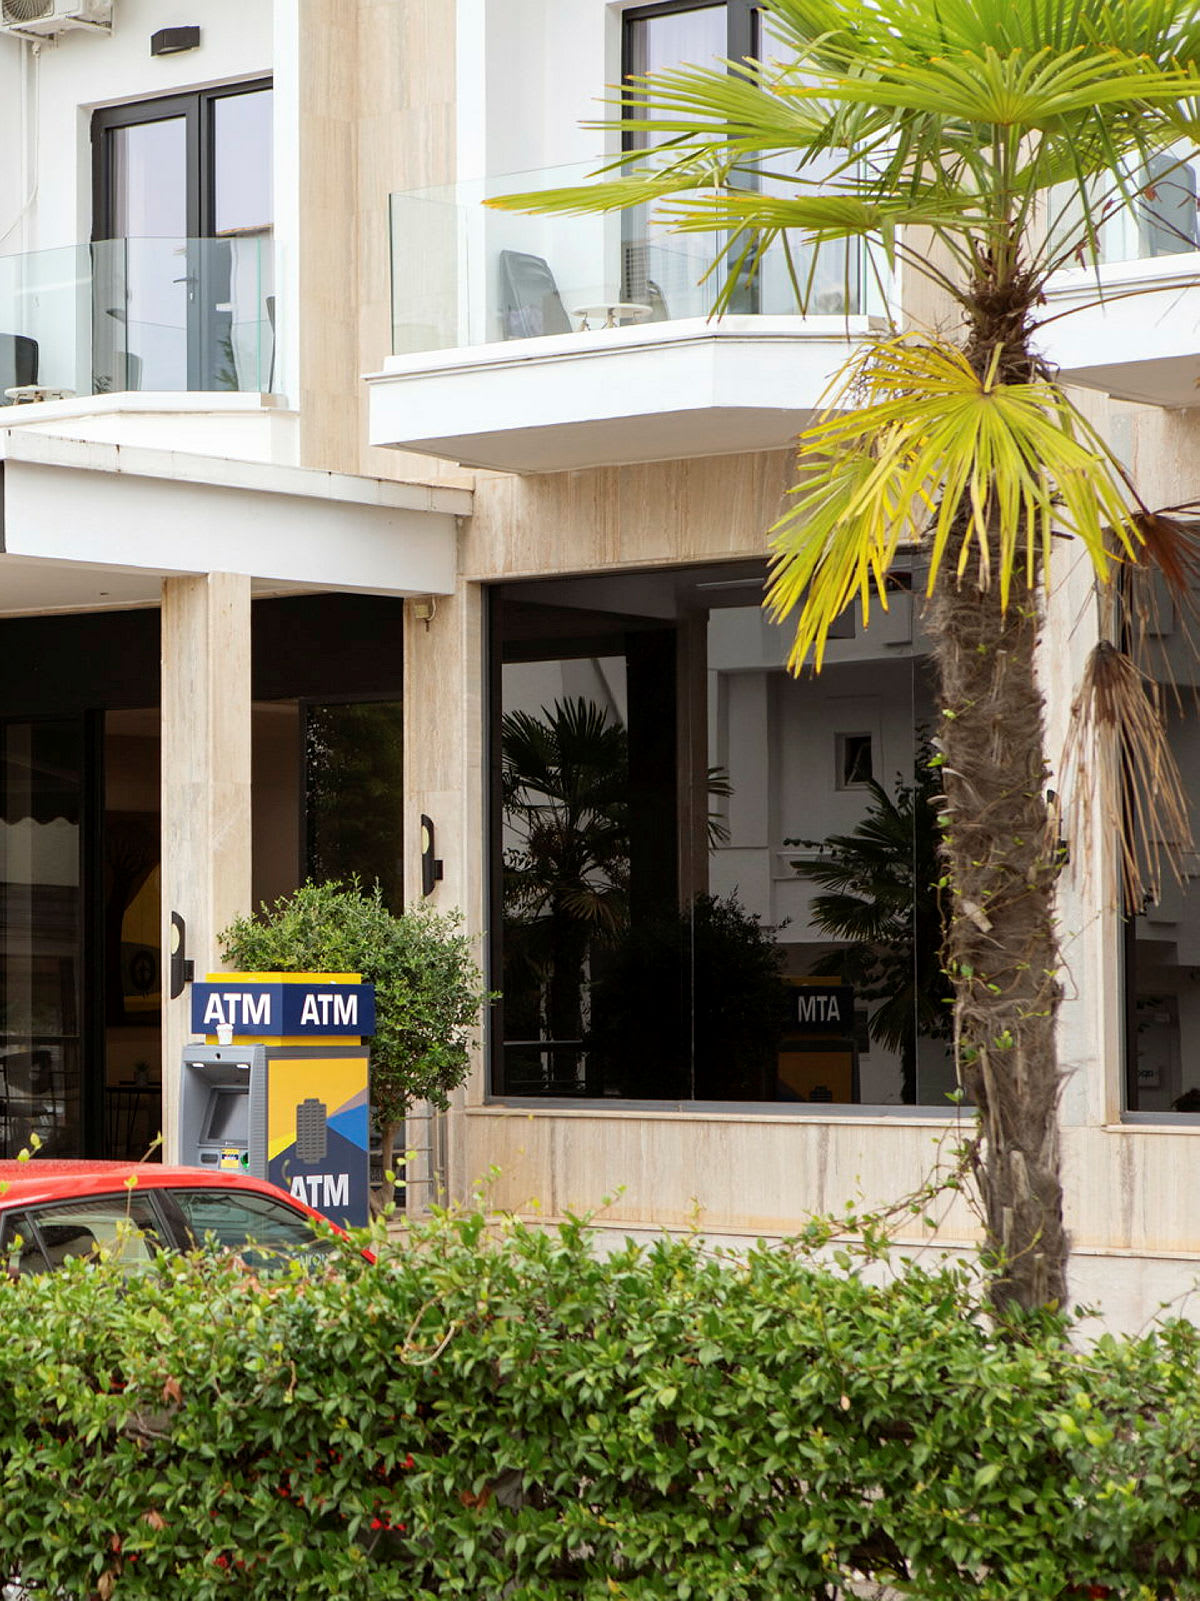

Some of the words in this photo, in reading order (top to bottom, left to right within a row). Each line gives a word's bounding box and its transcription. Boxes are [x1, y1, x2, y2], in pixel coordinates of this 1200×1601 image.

[203, 993, 271, 1025] ATM
[300, 994, 358, 1025] ATM
[290, 1174, 349, 1207] ATM
